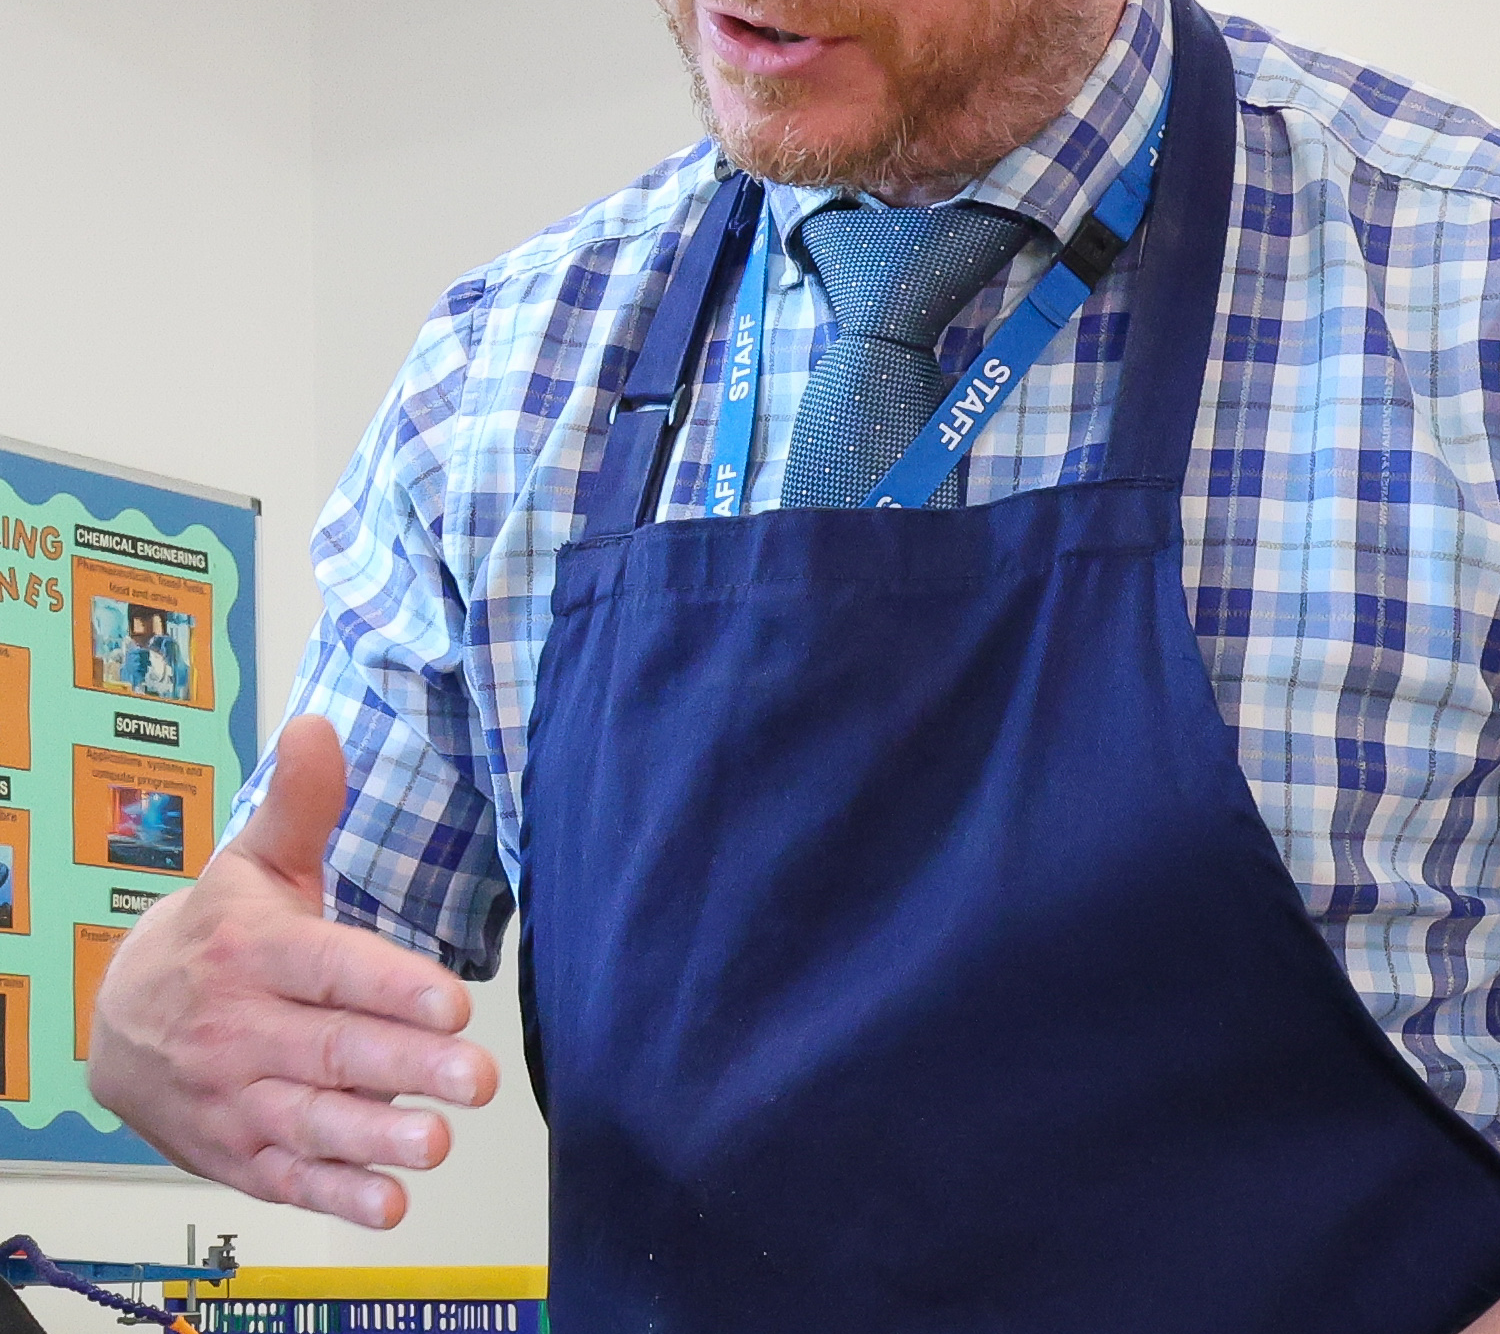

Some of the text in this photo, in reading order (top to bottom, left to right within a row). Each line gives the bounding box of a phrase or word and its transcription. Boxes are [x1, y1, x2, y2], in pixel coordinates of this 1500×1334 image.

[729, 313, 756, 401] STAFF
[938, 358, 1011, 451] STAFF
[76, 528, 135, 554] CHEMICAL
[116, 716, 177, 740] SOFTWARE
